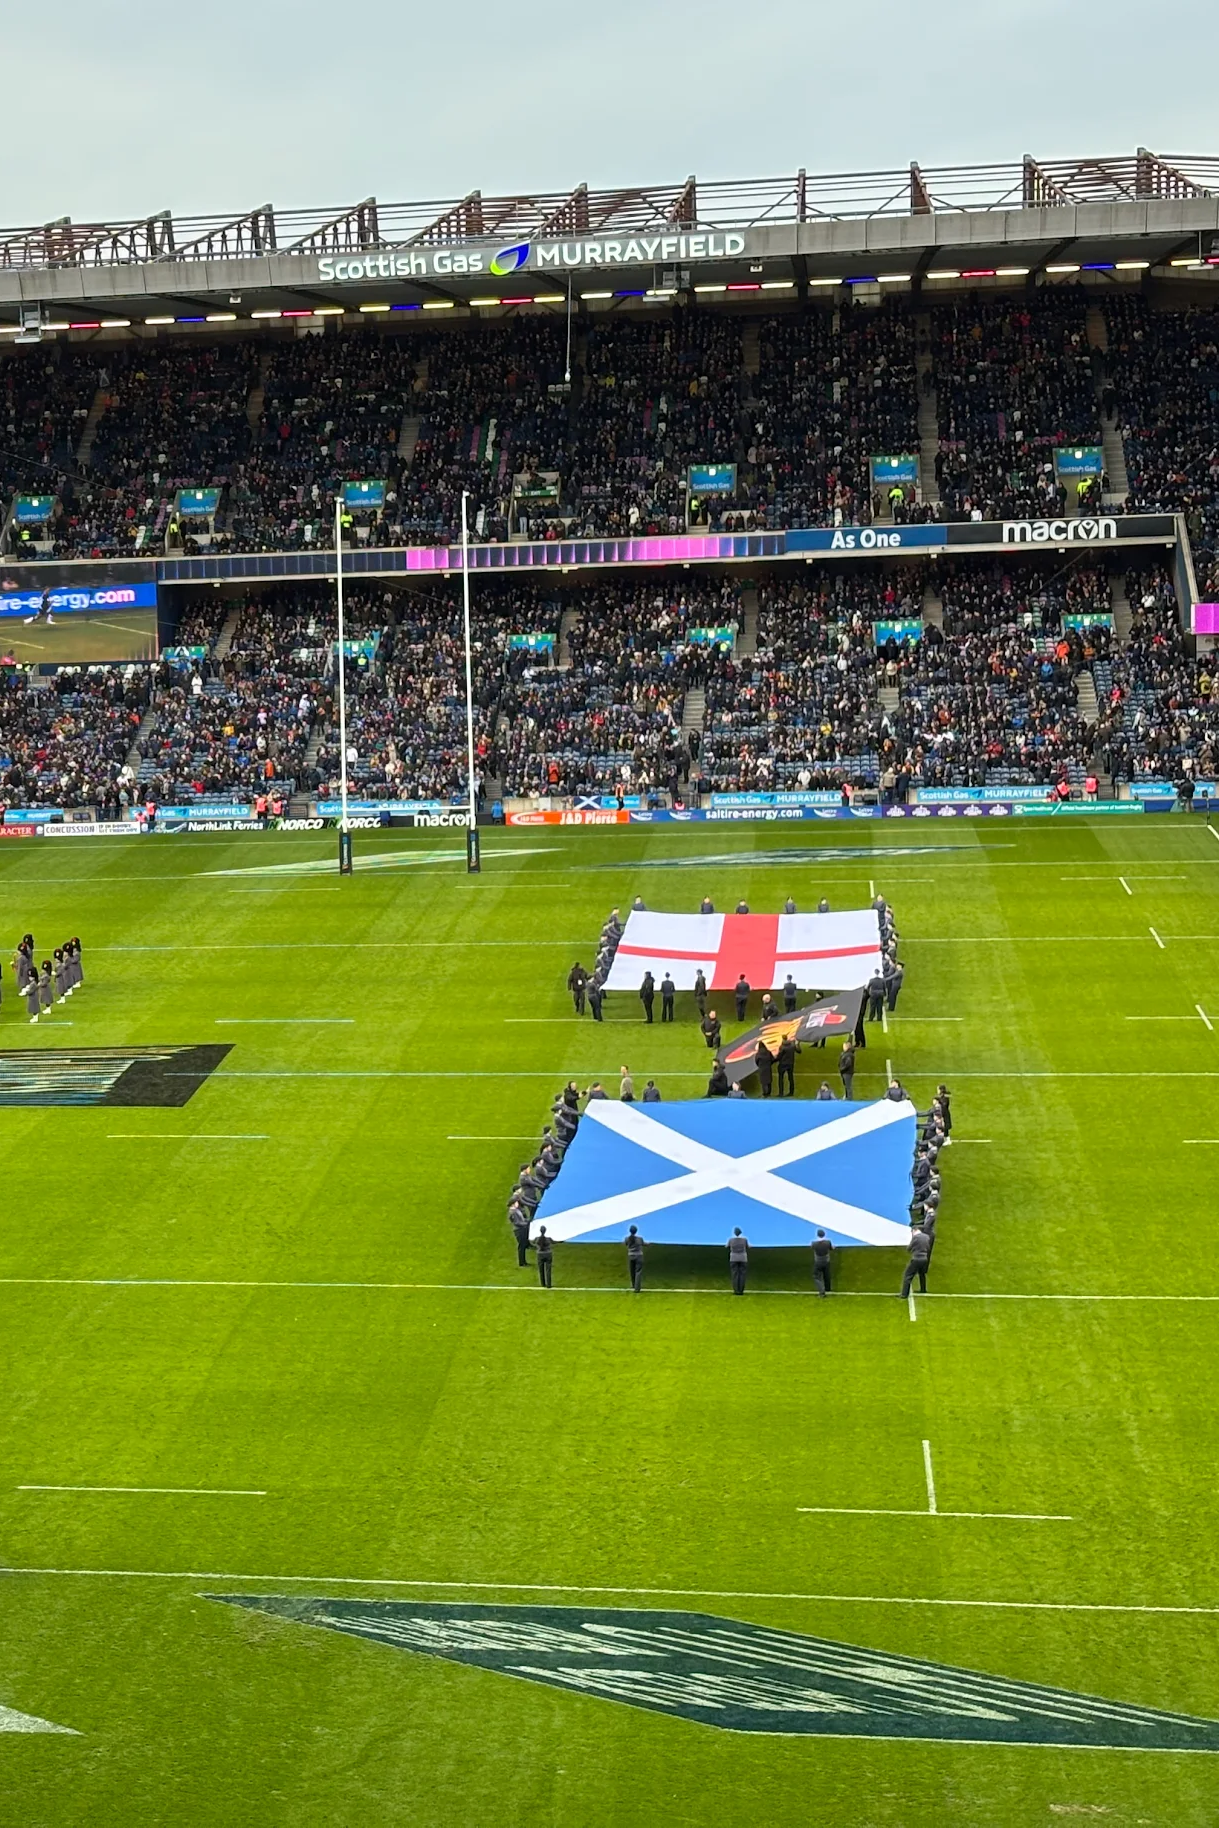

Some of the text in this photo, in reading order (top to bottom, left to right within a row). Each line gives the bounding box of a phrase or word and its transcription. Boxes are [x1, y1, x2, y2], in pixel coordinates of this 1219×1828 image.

[318, 232, 745, 281] Scottish Gas MURRAYFIELD
[1003, 519, 1117, 543] macron
[831, 529, 901, 548] As One
[714, 794, 841, 804] Scottish Gas MURRAYFIELD
[920, 791, 952, 800] Scottish
[953, 791, 969, 799] Gas
[189, 807, 248, 816] MURRAYFIELD
[706, 808, 803, 820] saltire-energy.com
[277, 818, 324, 830] NORCO
[560, 812, 617, 825] J&D Pierce
[46, 826, 95, 834] CONCUSSION
[188, 820, 263, 832] NorthLink Ferries
